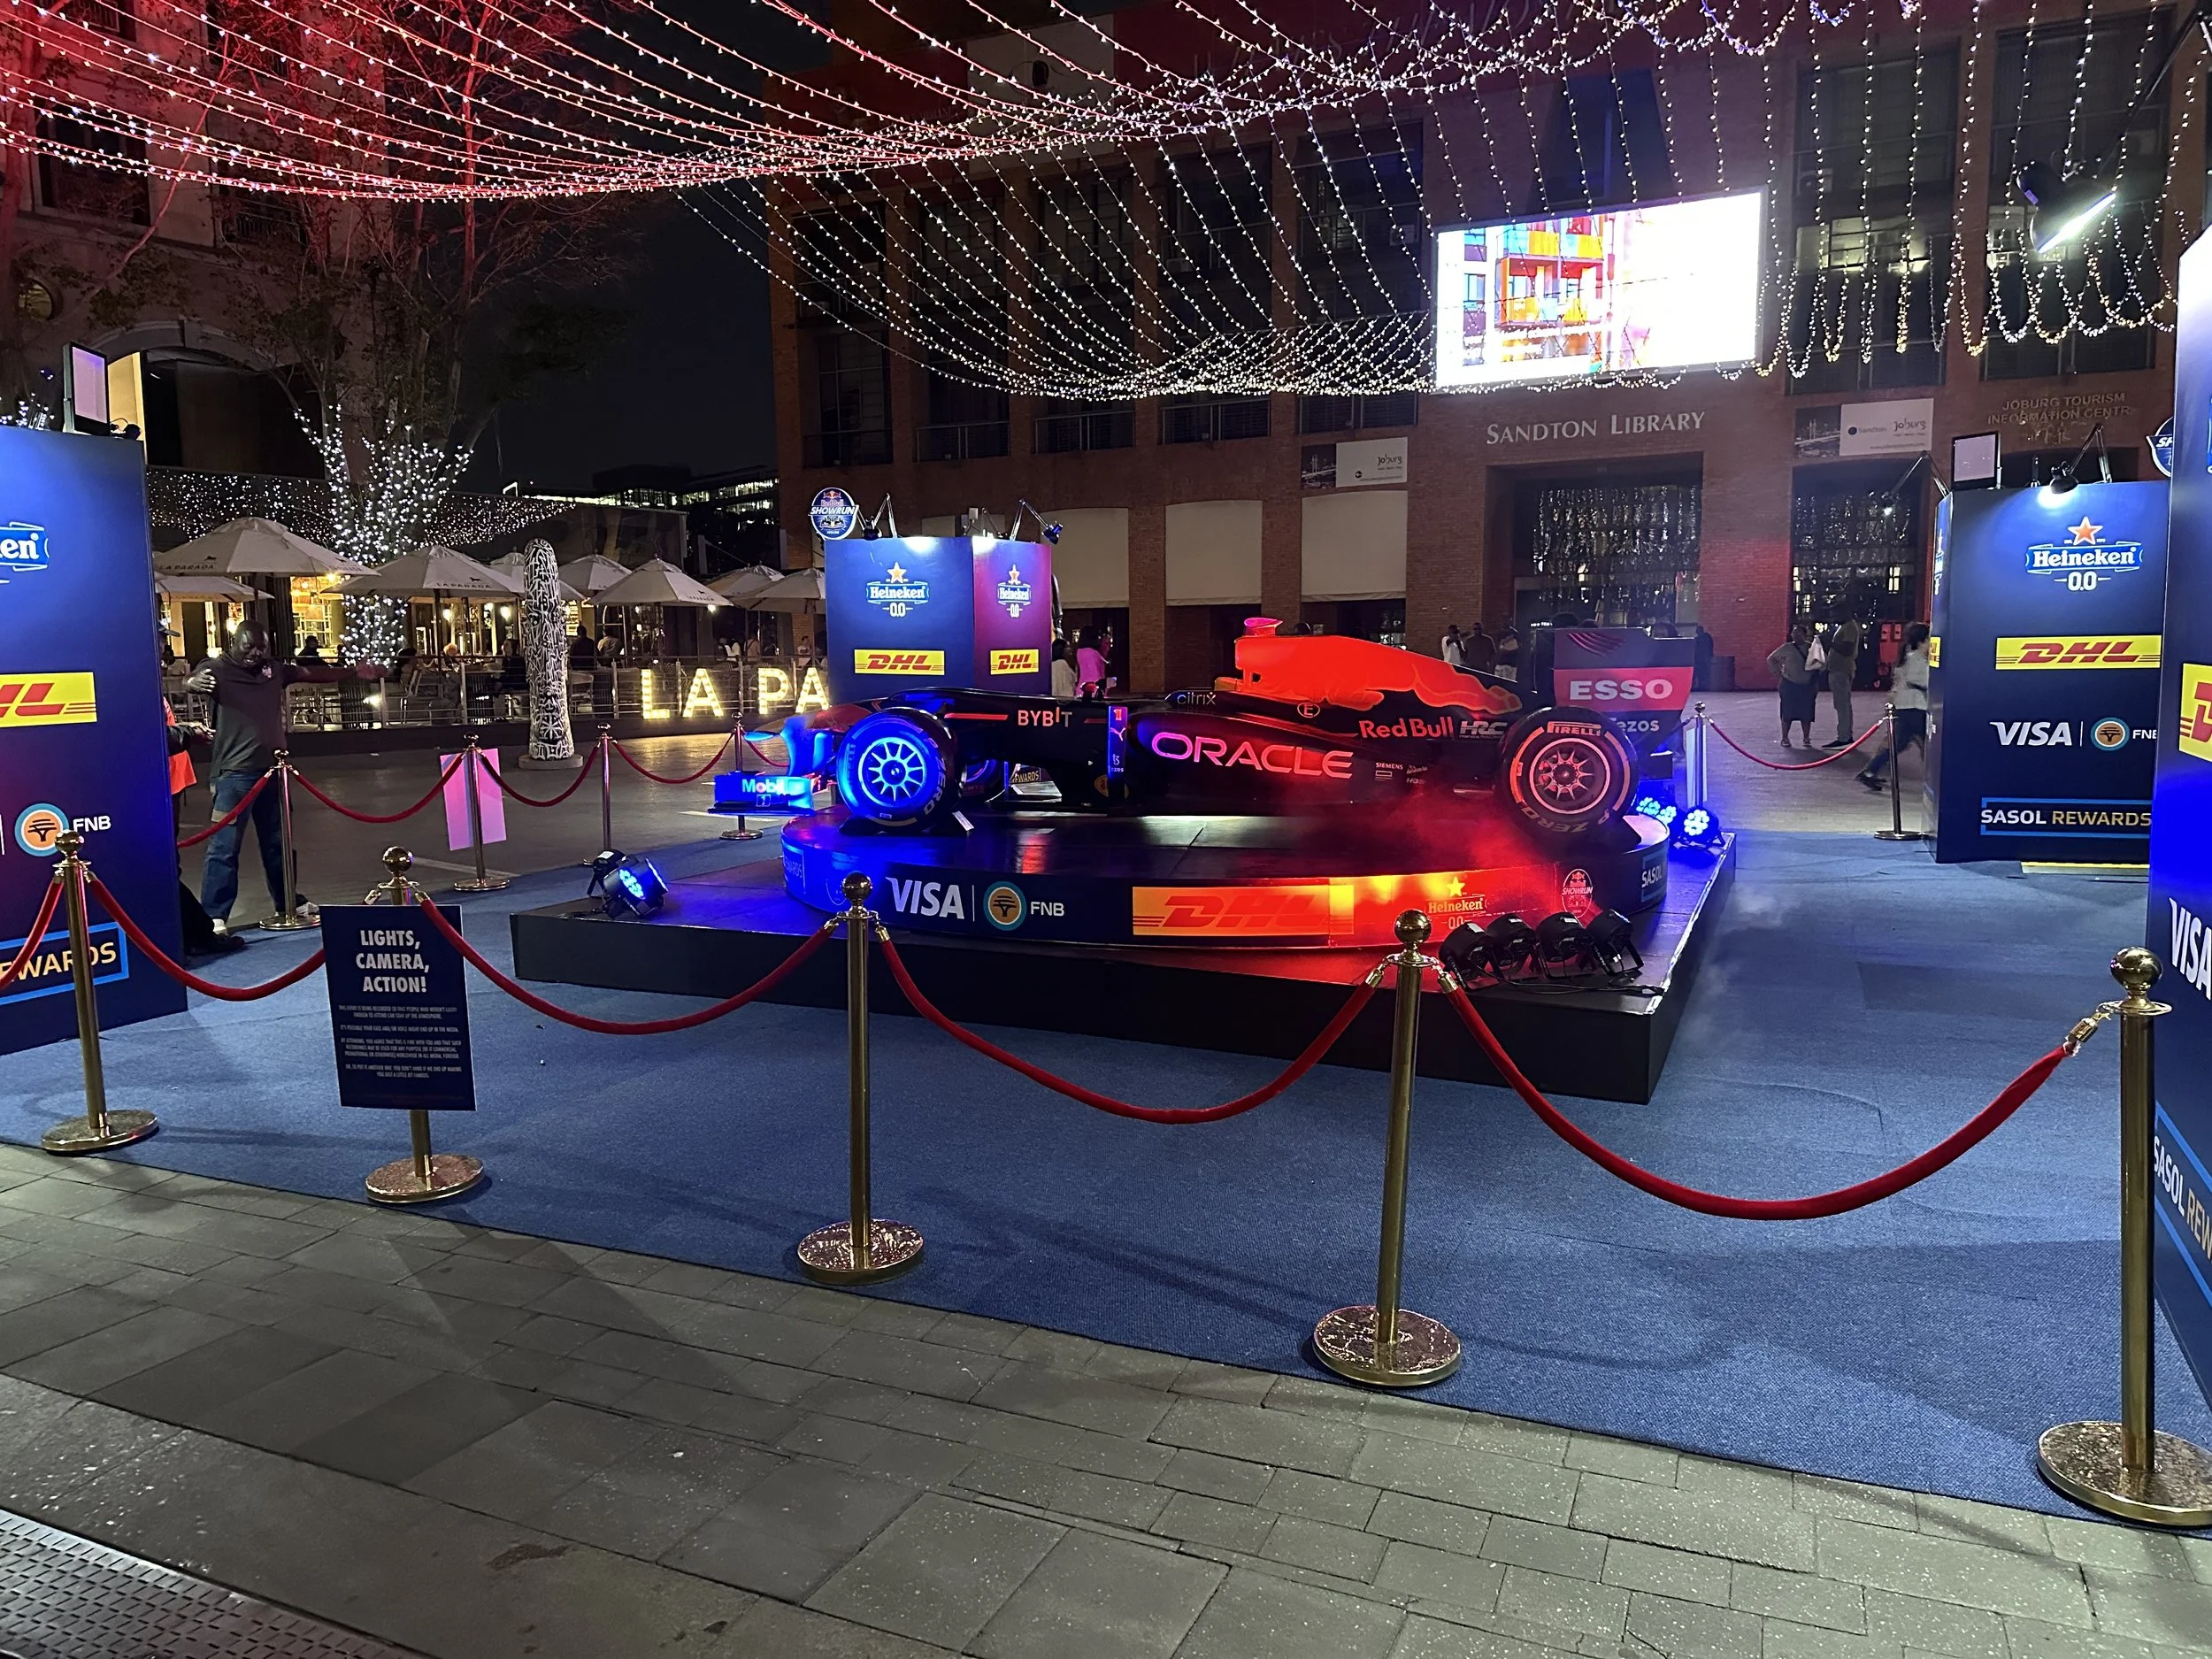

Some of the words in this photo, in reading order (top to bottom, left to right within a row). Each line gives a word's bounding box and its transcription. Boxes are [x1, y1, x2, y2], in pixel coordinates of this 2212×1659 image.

[2002, 397, 2060, 411] JOBURG
[2063, 392, 2126, 406] TOURISM
[1486, 419, 1597, 444] SANDTON
[1611, 411, 1705, 434] LIBRARY
[810, 506, 855, 515] SHOWRUN
[2033, 547, 2137, 567] Heineken
[870, 586, 926, 599] Heineken
[867, 654, 932, 669] DHL
[2018, 641, 2140, 664] DHL
[998, 654, 1033, 670] DHL
[641, 668, 724, 719] LA
[1177, 692, 1217, 705] citrix
[1570, 679, 1673, 700] ESSO
[1018, 707, 1072, 727] BYBIT
[1460, 720, 1508, 735] HRC
[1547, 721, 1601, 737] PIRELLI
[1990, 721, 2072, 747] VISA
[1152, 732, 1354, 779] ORACLE
[1375, 762, 1403, 771] SIEMENS
[73, 815, 111, 833] FNB
[1980, 810, 2047, 825] SASOL
[2052, 810, 2153, 827] REWARDS
[886, 877, 964, 919] VISA
[1561, 886, 1594, 895] SHOWRUN
[1030, 902, 1064, 917] FNB
[1162, 894, 1327, 928] DHL
[1428, 897, 1484, 914] Heineken
[360, 930, 420, 949] LIGHTS,
[356, 953, 429, 973] CAMERA,
[363, 976, 426, 993] ACTION!
[2154, 1135, 2185, 1217] SASOL
